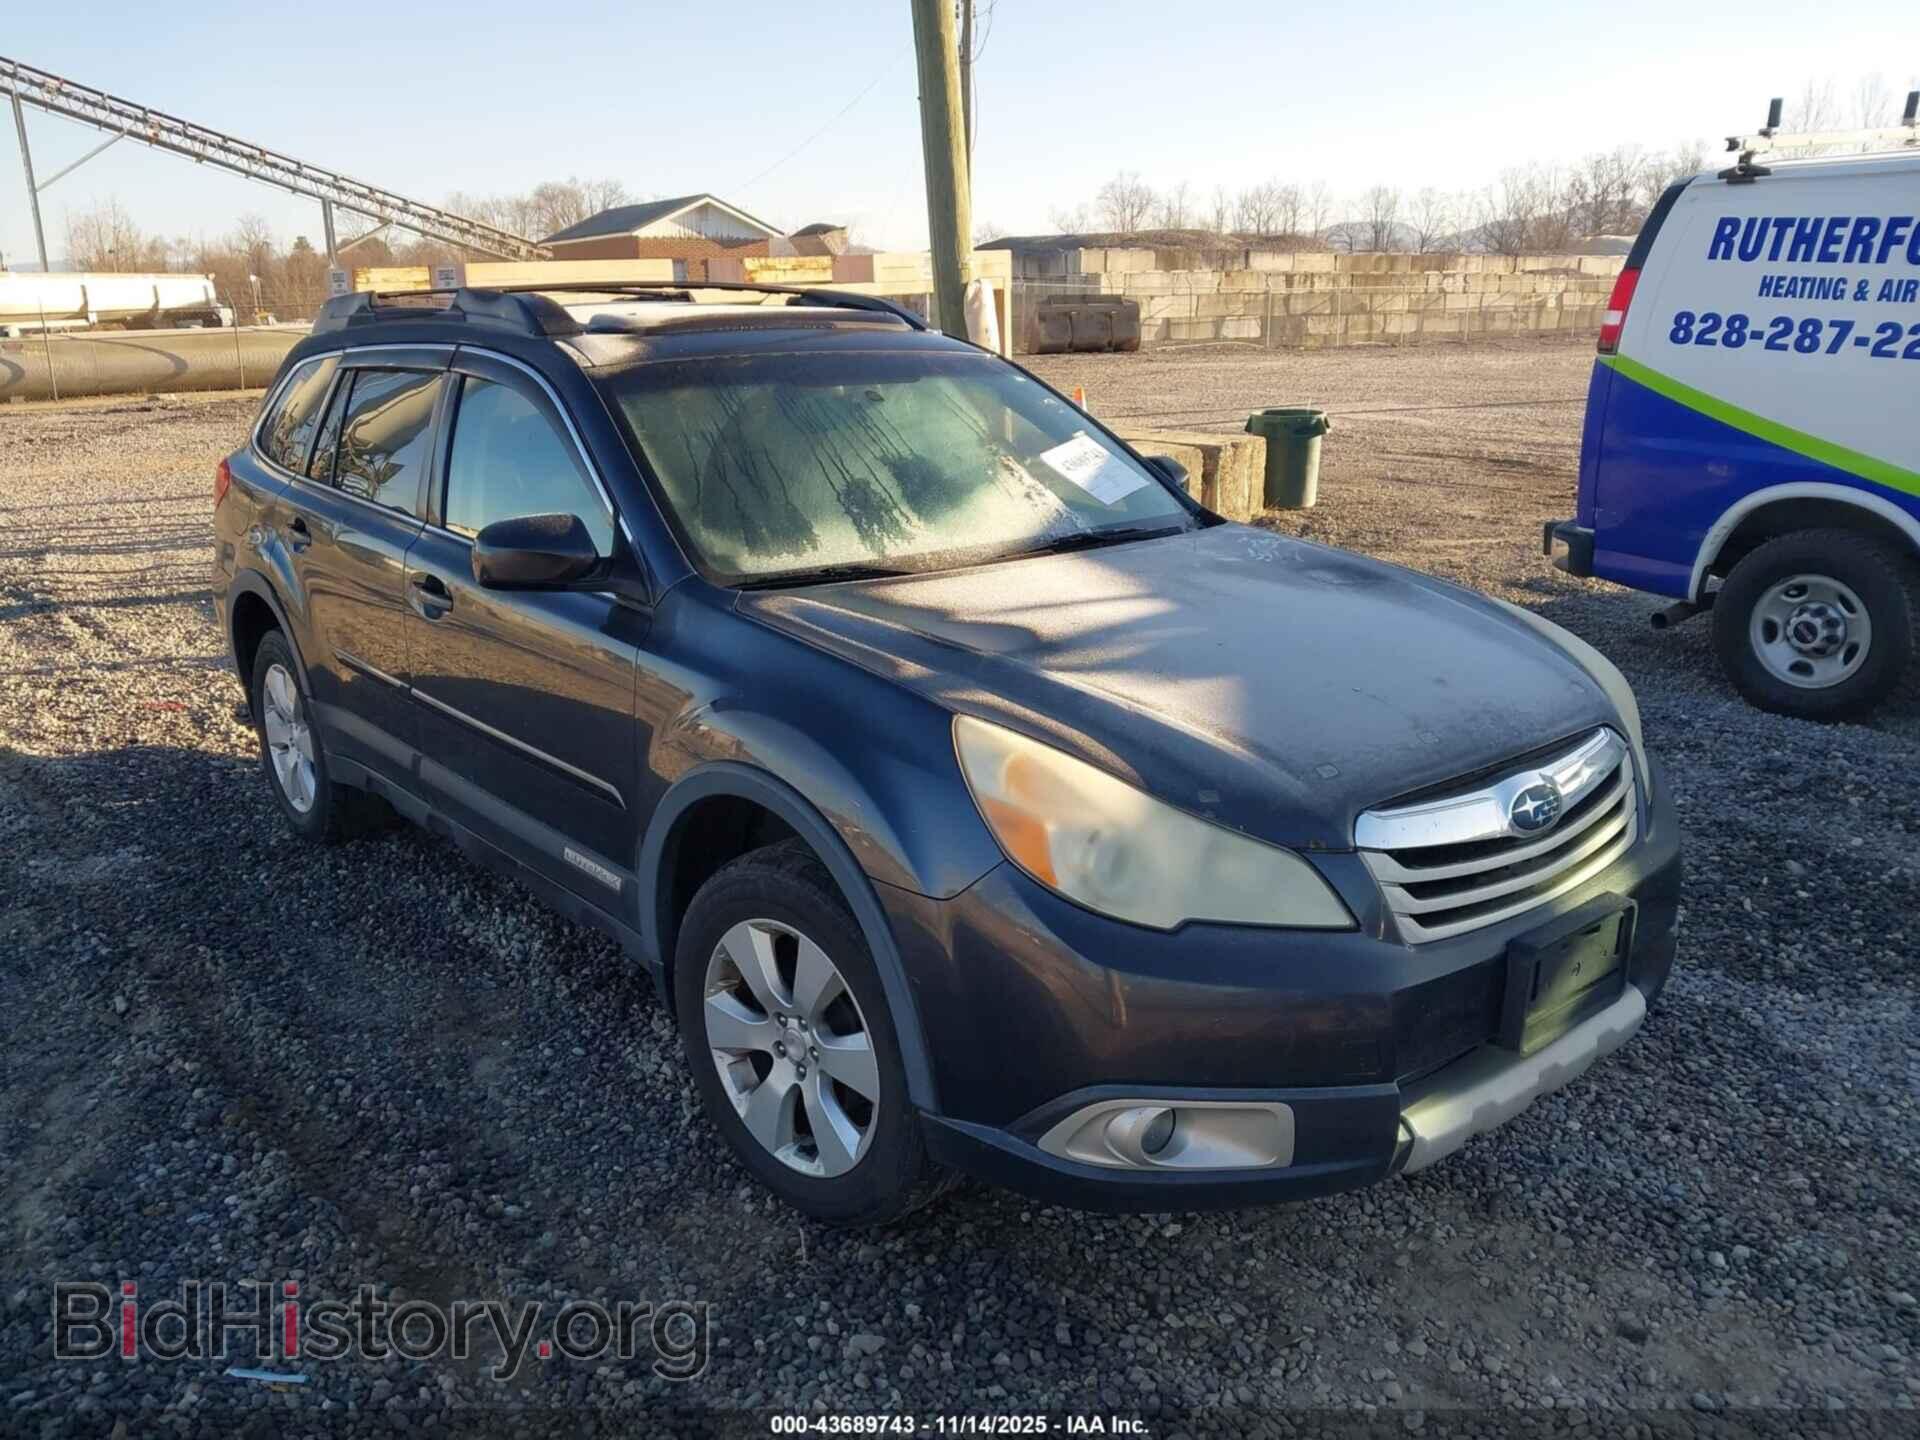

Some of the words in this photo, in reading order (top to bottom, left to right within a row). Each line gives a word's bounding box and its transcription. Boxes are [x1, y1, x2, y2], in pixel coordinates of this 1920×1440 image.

[1758, 275, 1848, 301] HEATING
[1853, 279, 1870, 302] &
[1876, 279, 1919, 303] AIR
